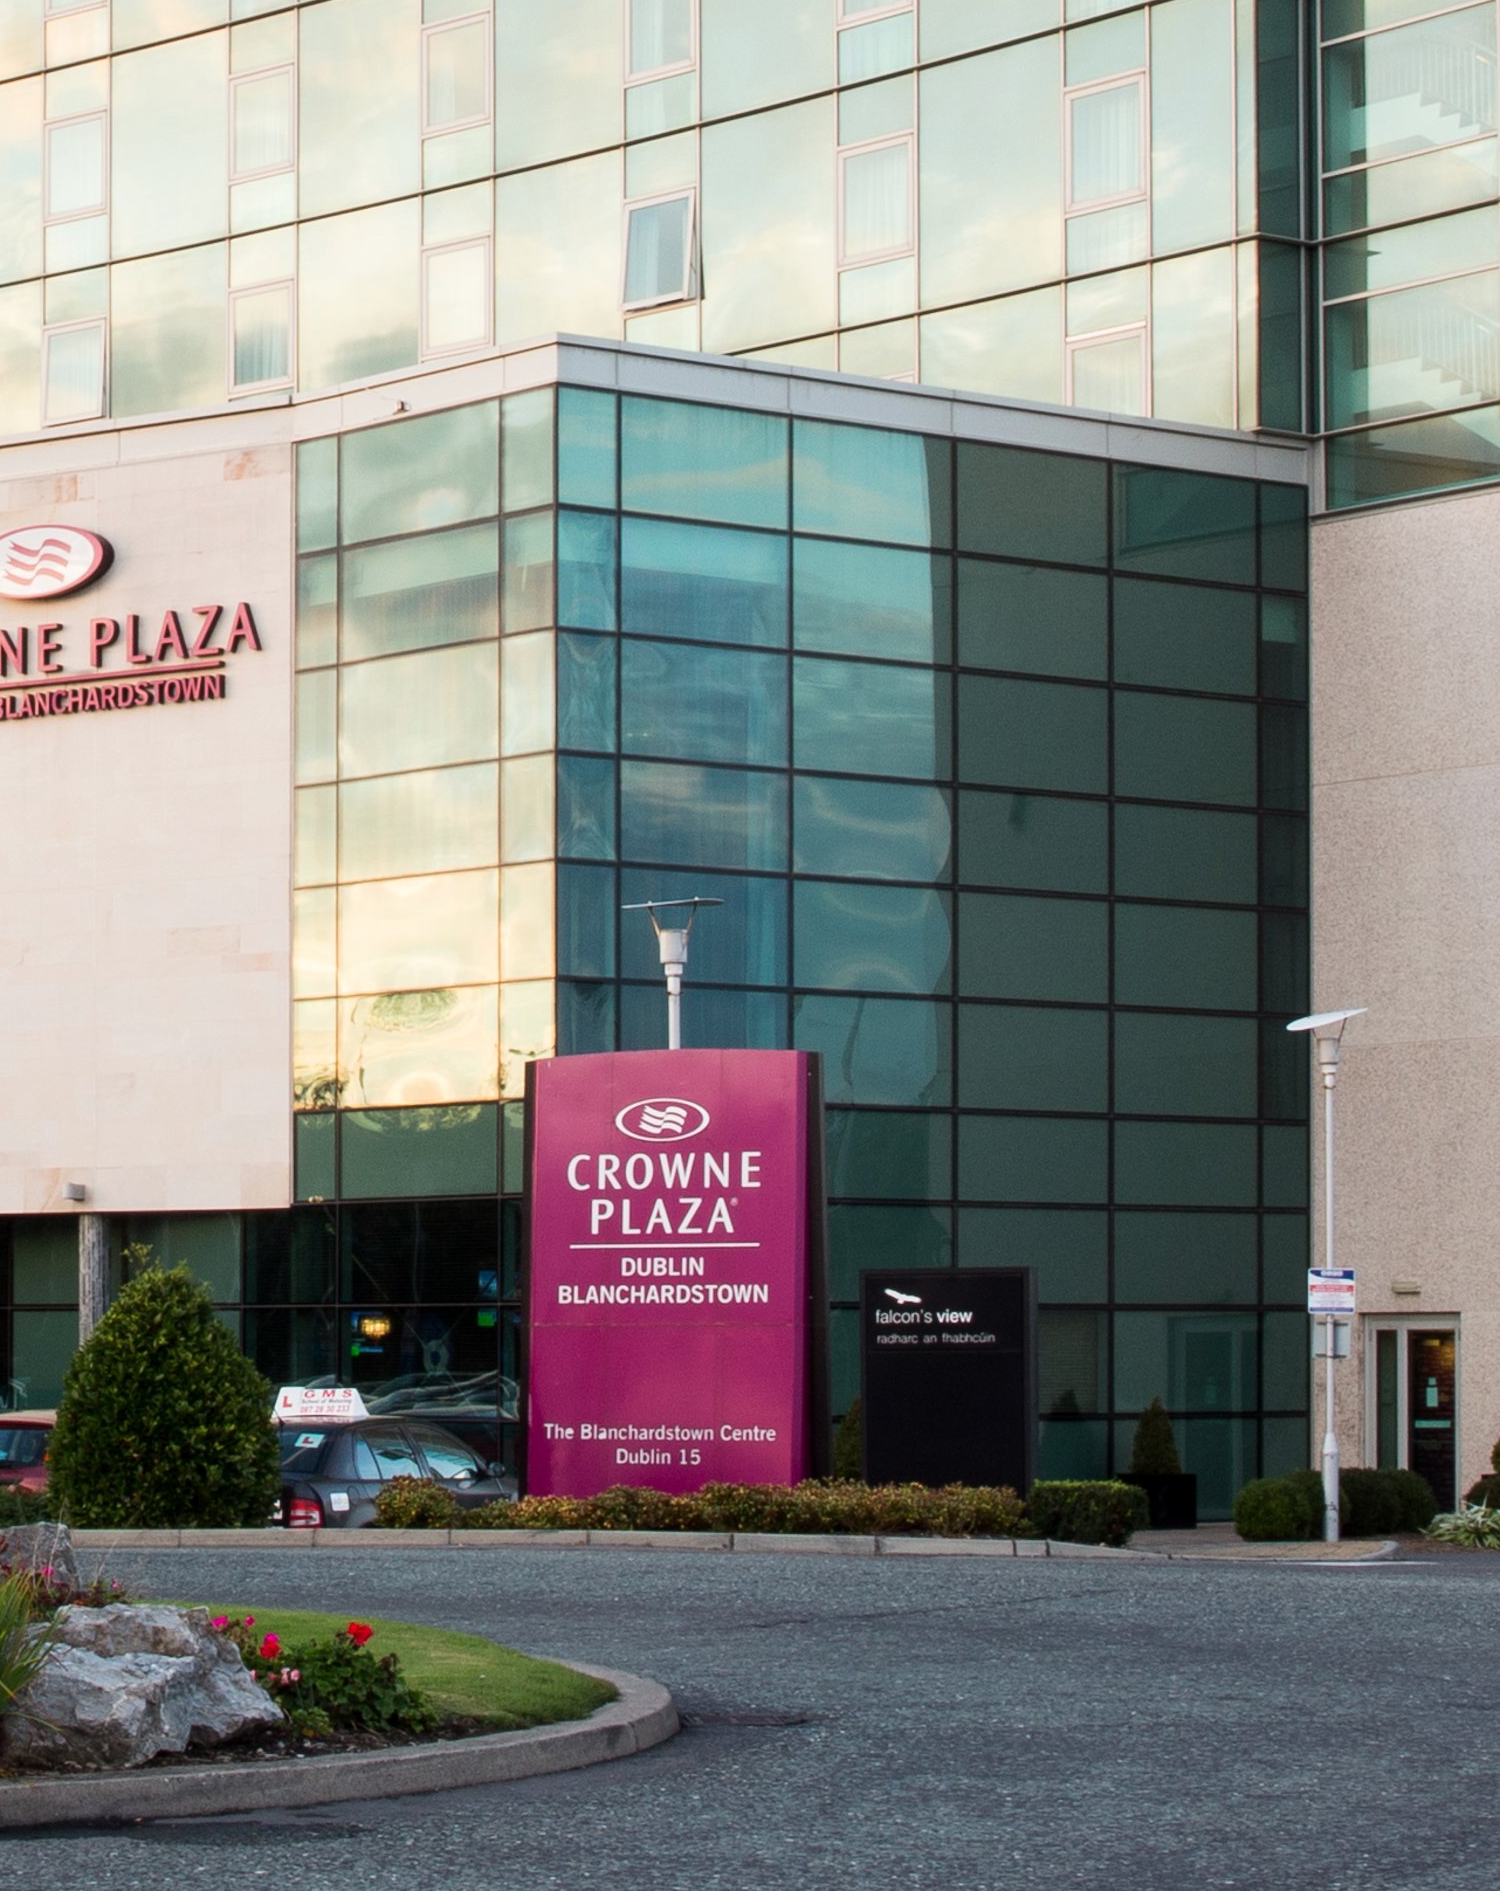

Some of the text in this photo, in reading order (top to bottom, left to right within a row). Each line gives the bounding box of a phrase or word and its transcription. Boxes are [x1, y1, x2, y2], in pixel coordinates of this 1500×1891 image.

[90, 601, 262, 668] PLAZA
[567, 1151, 762, 1191] CROWNE
[590, 1197, 735, 1235] PLAZA
[621, 1256, 704, 1277] DUBLIN
[558, 1284, 769, 1305] BLANCHARDSTOWN
[875, 1308, 973, 1324] falcon's view
[876, 1333, 919, 1345] radharc
[923, 1334, 937, 1344] an
[282, 1396, 292, 1408] L
[543, 1423, 777, 1442] The Blanchardstown Centre
[616, 1447, 702, 1466] Dublin 15
